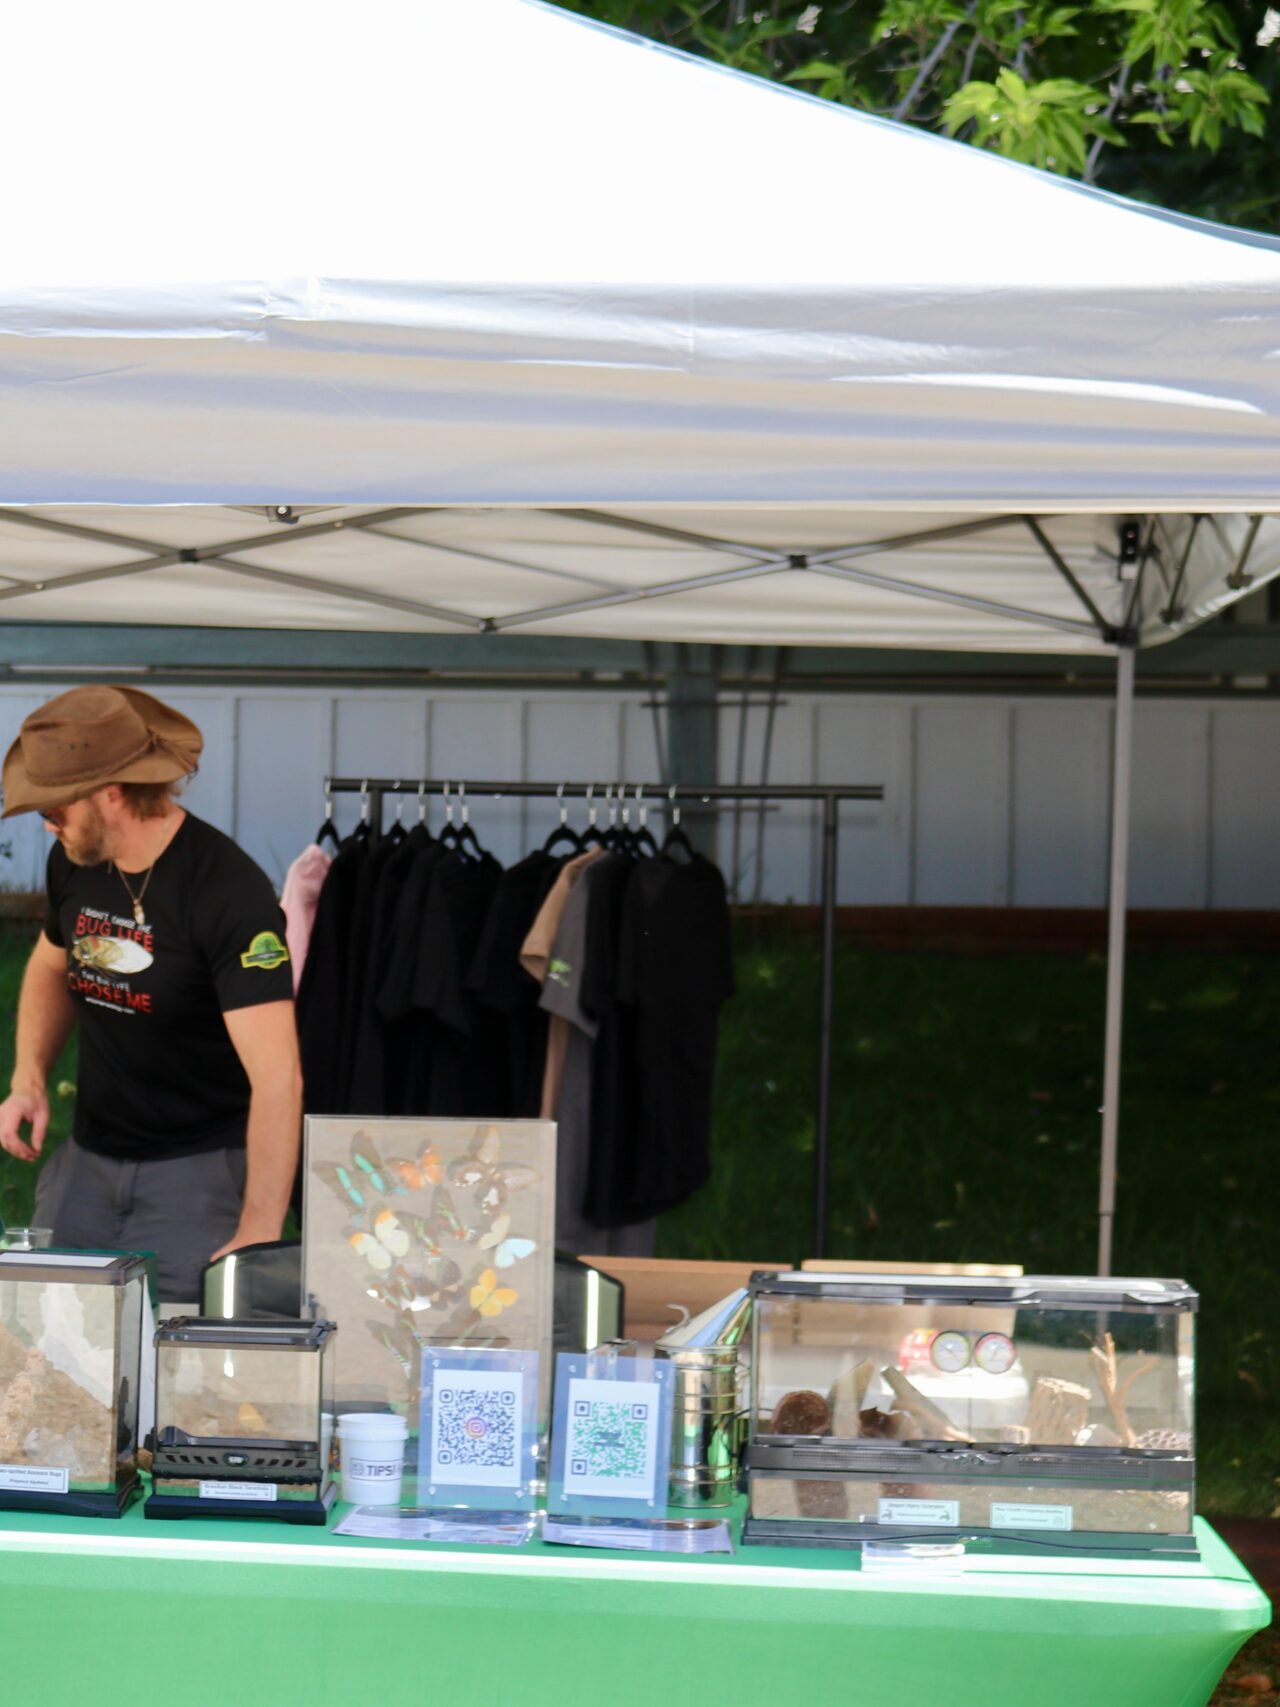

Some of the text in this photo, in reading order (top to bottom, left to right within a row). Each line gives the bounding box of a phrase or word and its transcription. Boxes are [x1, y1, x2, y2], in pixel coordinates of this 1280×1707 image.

[75, 913, 154, 953] BUG LIFE
[68, 972, 122, 1004] CHOSE
[125, 991, 153, 1013] ME
